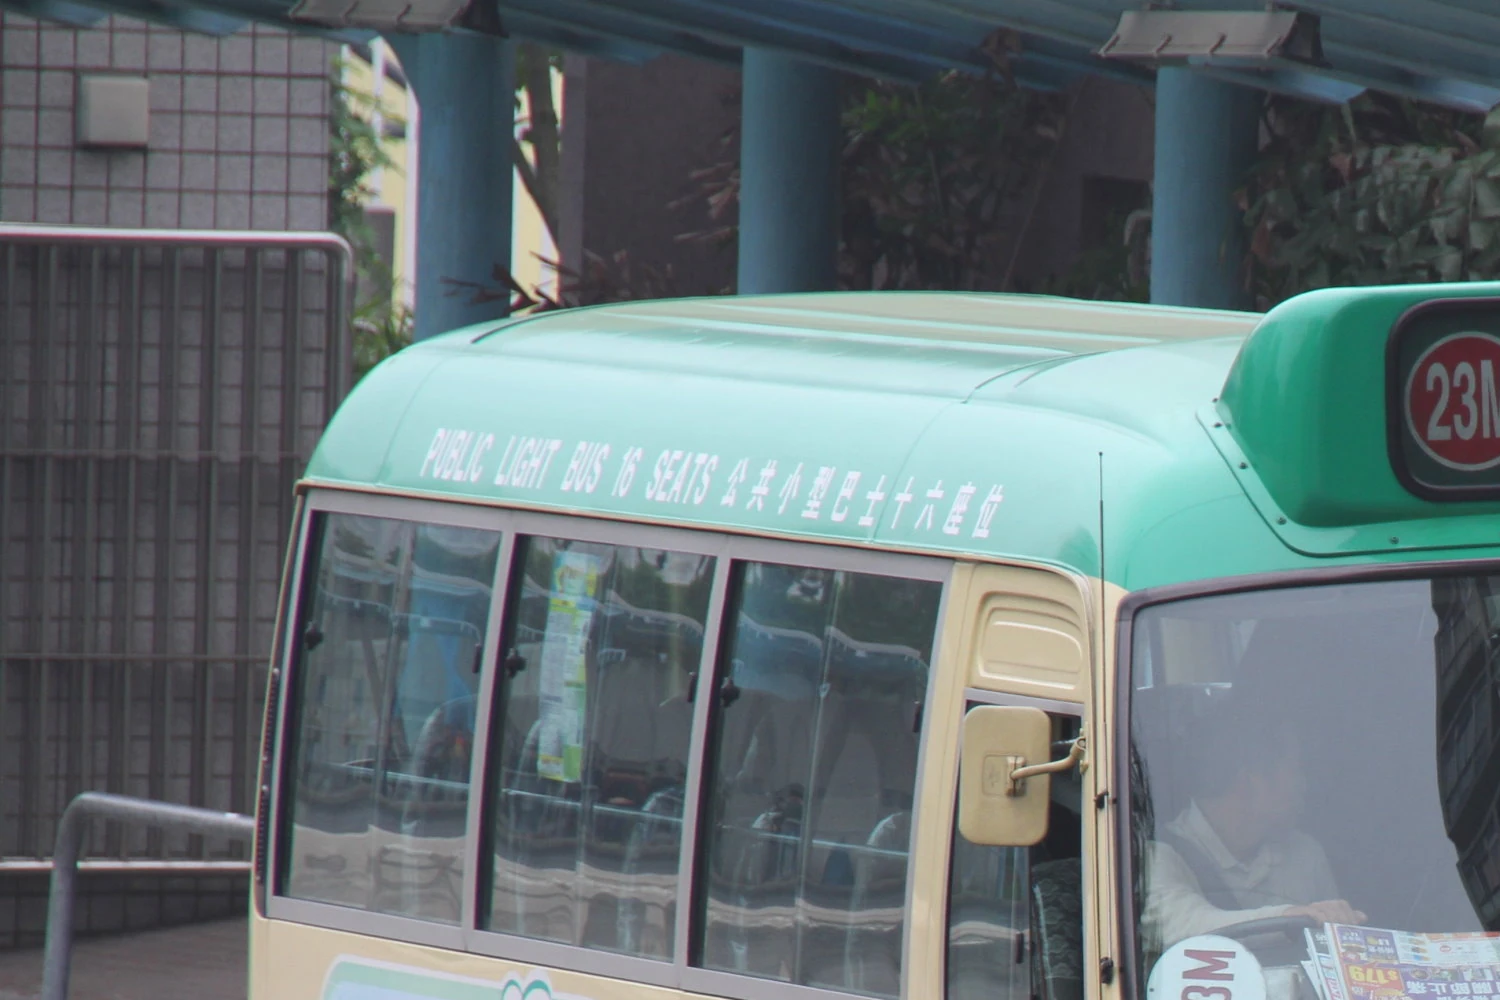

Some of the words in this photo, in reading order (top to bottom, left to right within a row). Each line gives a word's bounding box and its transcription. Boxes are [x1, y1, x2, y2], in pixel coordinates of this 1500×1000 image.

[419, 428, 495, 483] PUBLIC
[494, 435, 563, 490] LIGHT
[560, 440, 610, 493] BUS
[611, 446, 644, 497] 16
[645, 449, 719, 505] SEATS
[720, 456, 1005, 539] 公共小型巴士十六座位
